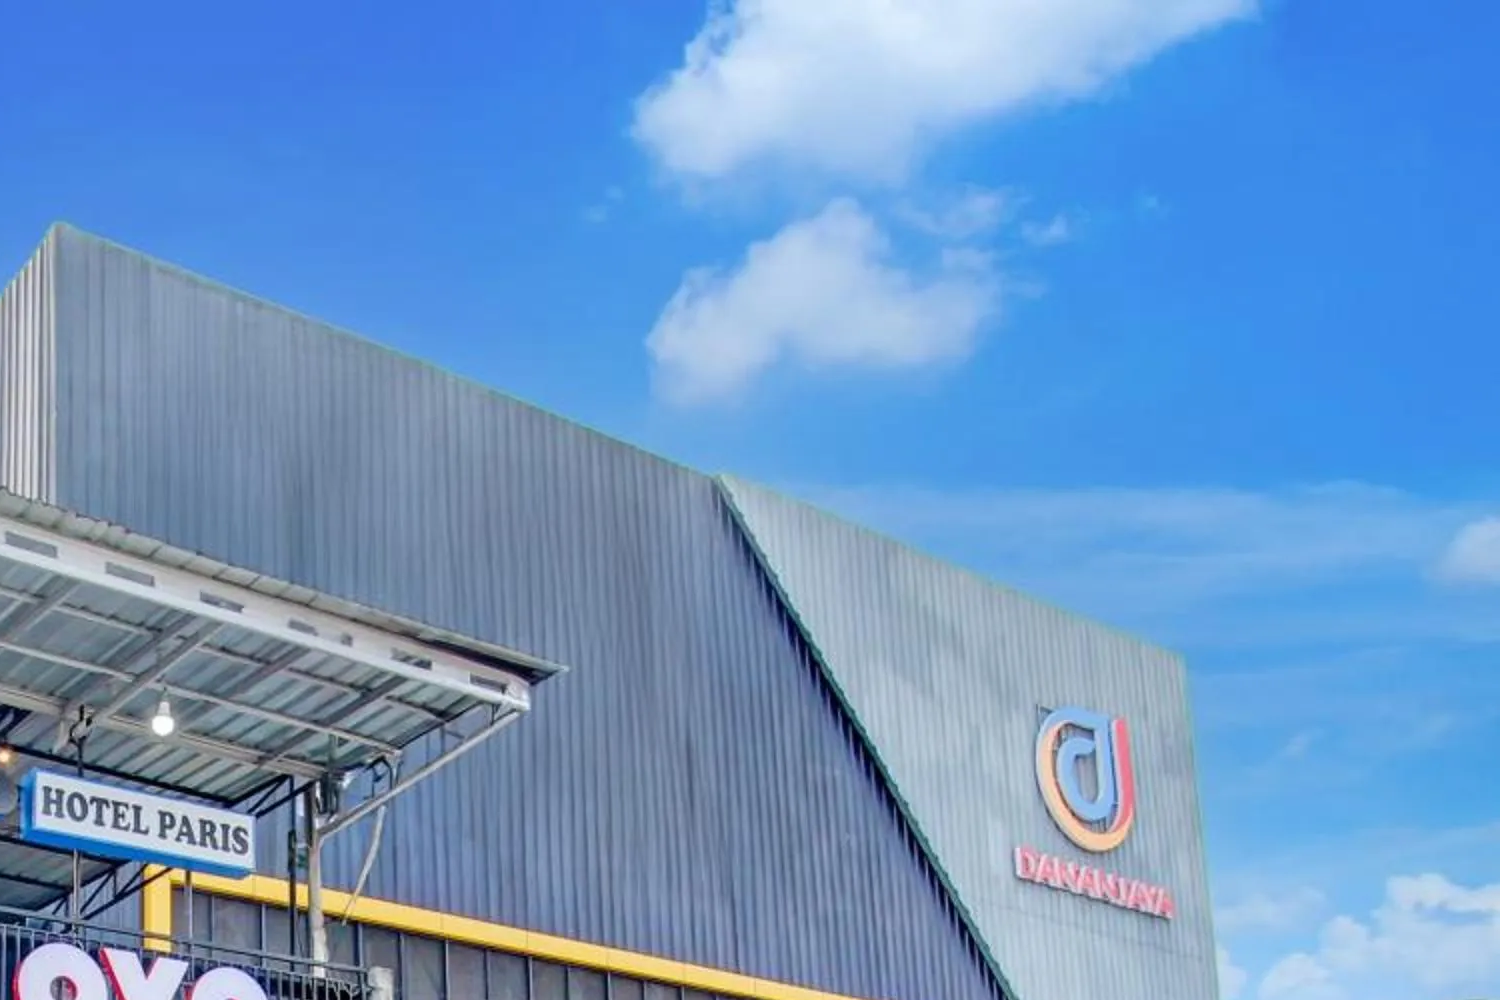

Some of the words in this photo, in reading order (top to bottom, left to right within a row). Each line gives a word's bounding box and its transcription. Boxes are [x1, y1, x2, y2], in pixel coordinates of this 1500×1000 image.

[41, 785, 150, 836] HOTEL
[156, 809, 250, 856] PARIS
[1014, 844, 1177, 920] DANANJAYA
